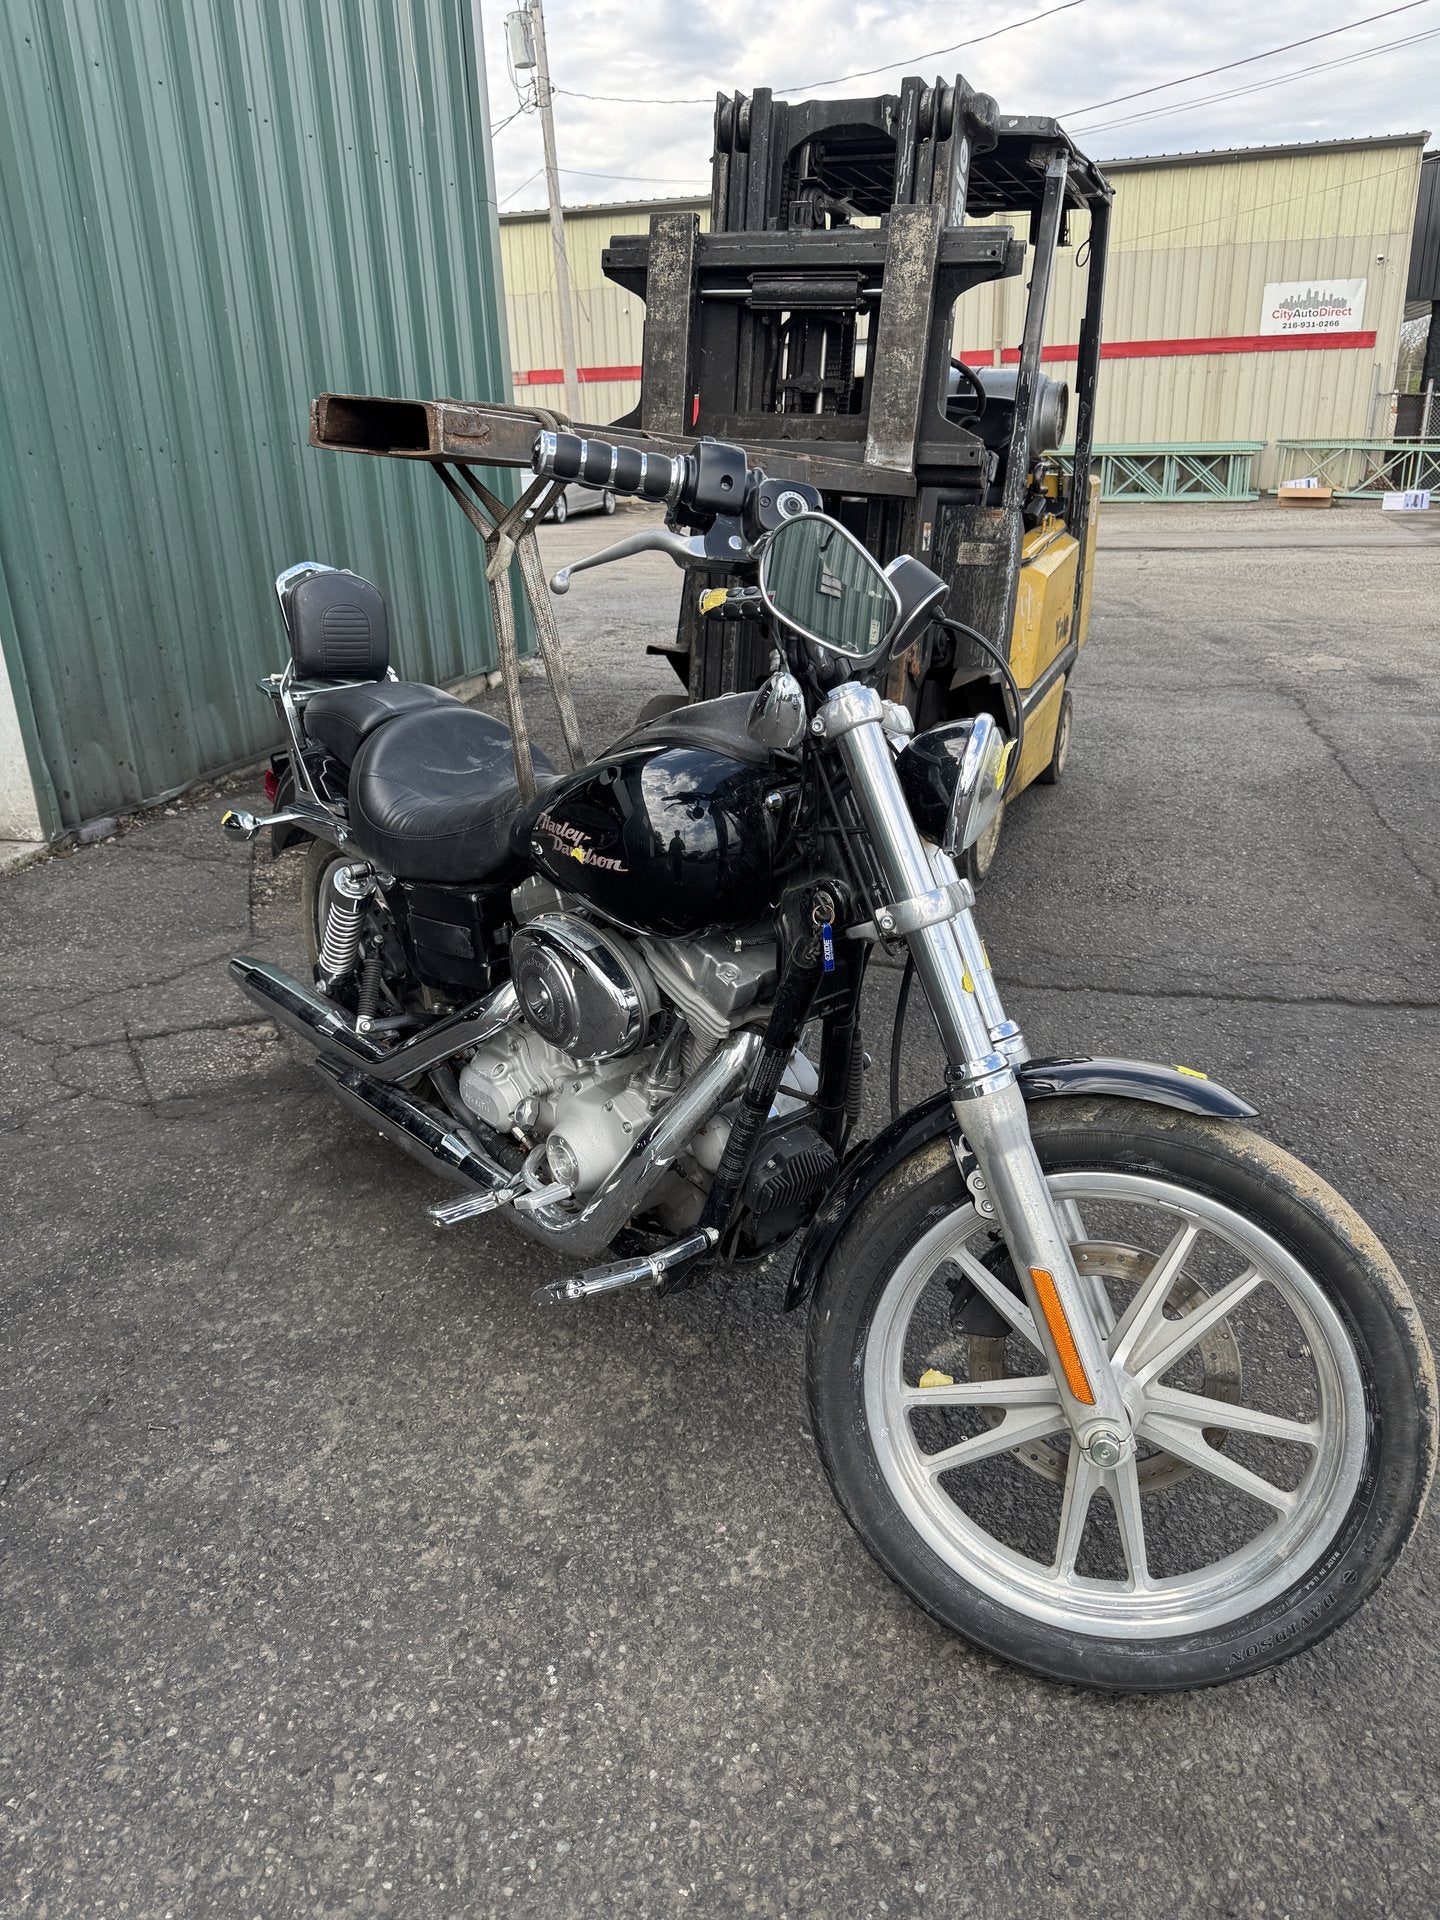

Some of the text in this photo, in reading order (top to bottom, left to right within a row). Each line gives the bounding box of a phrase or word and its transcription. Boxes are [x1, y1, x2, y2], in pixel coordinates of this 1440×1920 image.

[1272, 307, 1352, 321] CityAutoDirect
[1282, 320, 1340, 329] 216-931-0266
[548, 833, 629, 872] Dadson
[1325, 1551, 1340, 1569] MADE
[1319, 1568, 1327, 1576] IN
[1229, 1591, 1338, 1665] DAVIDSON
